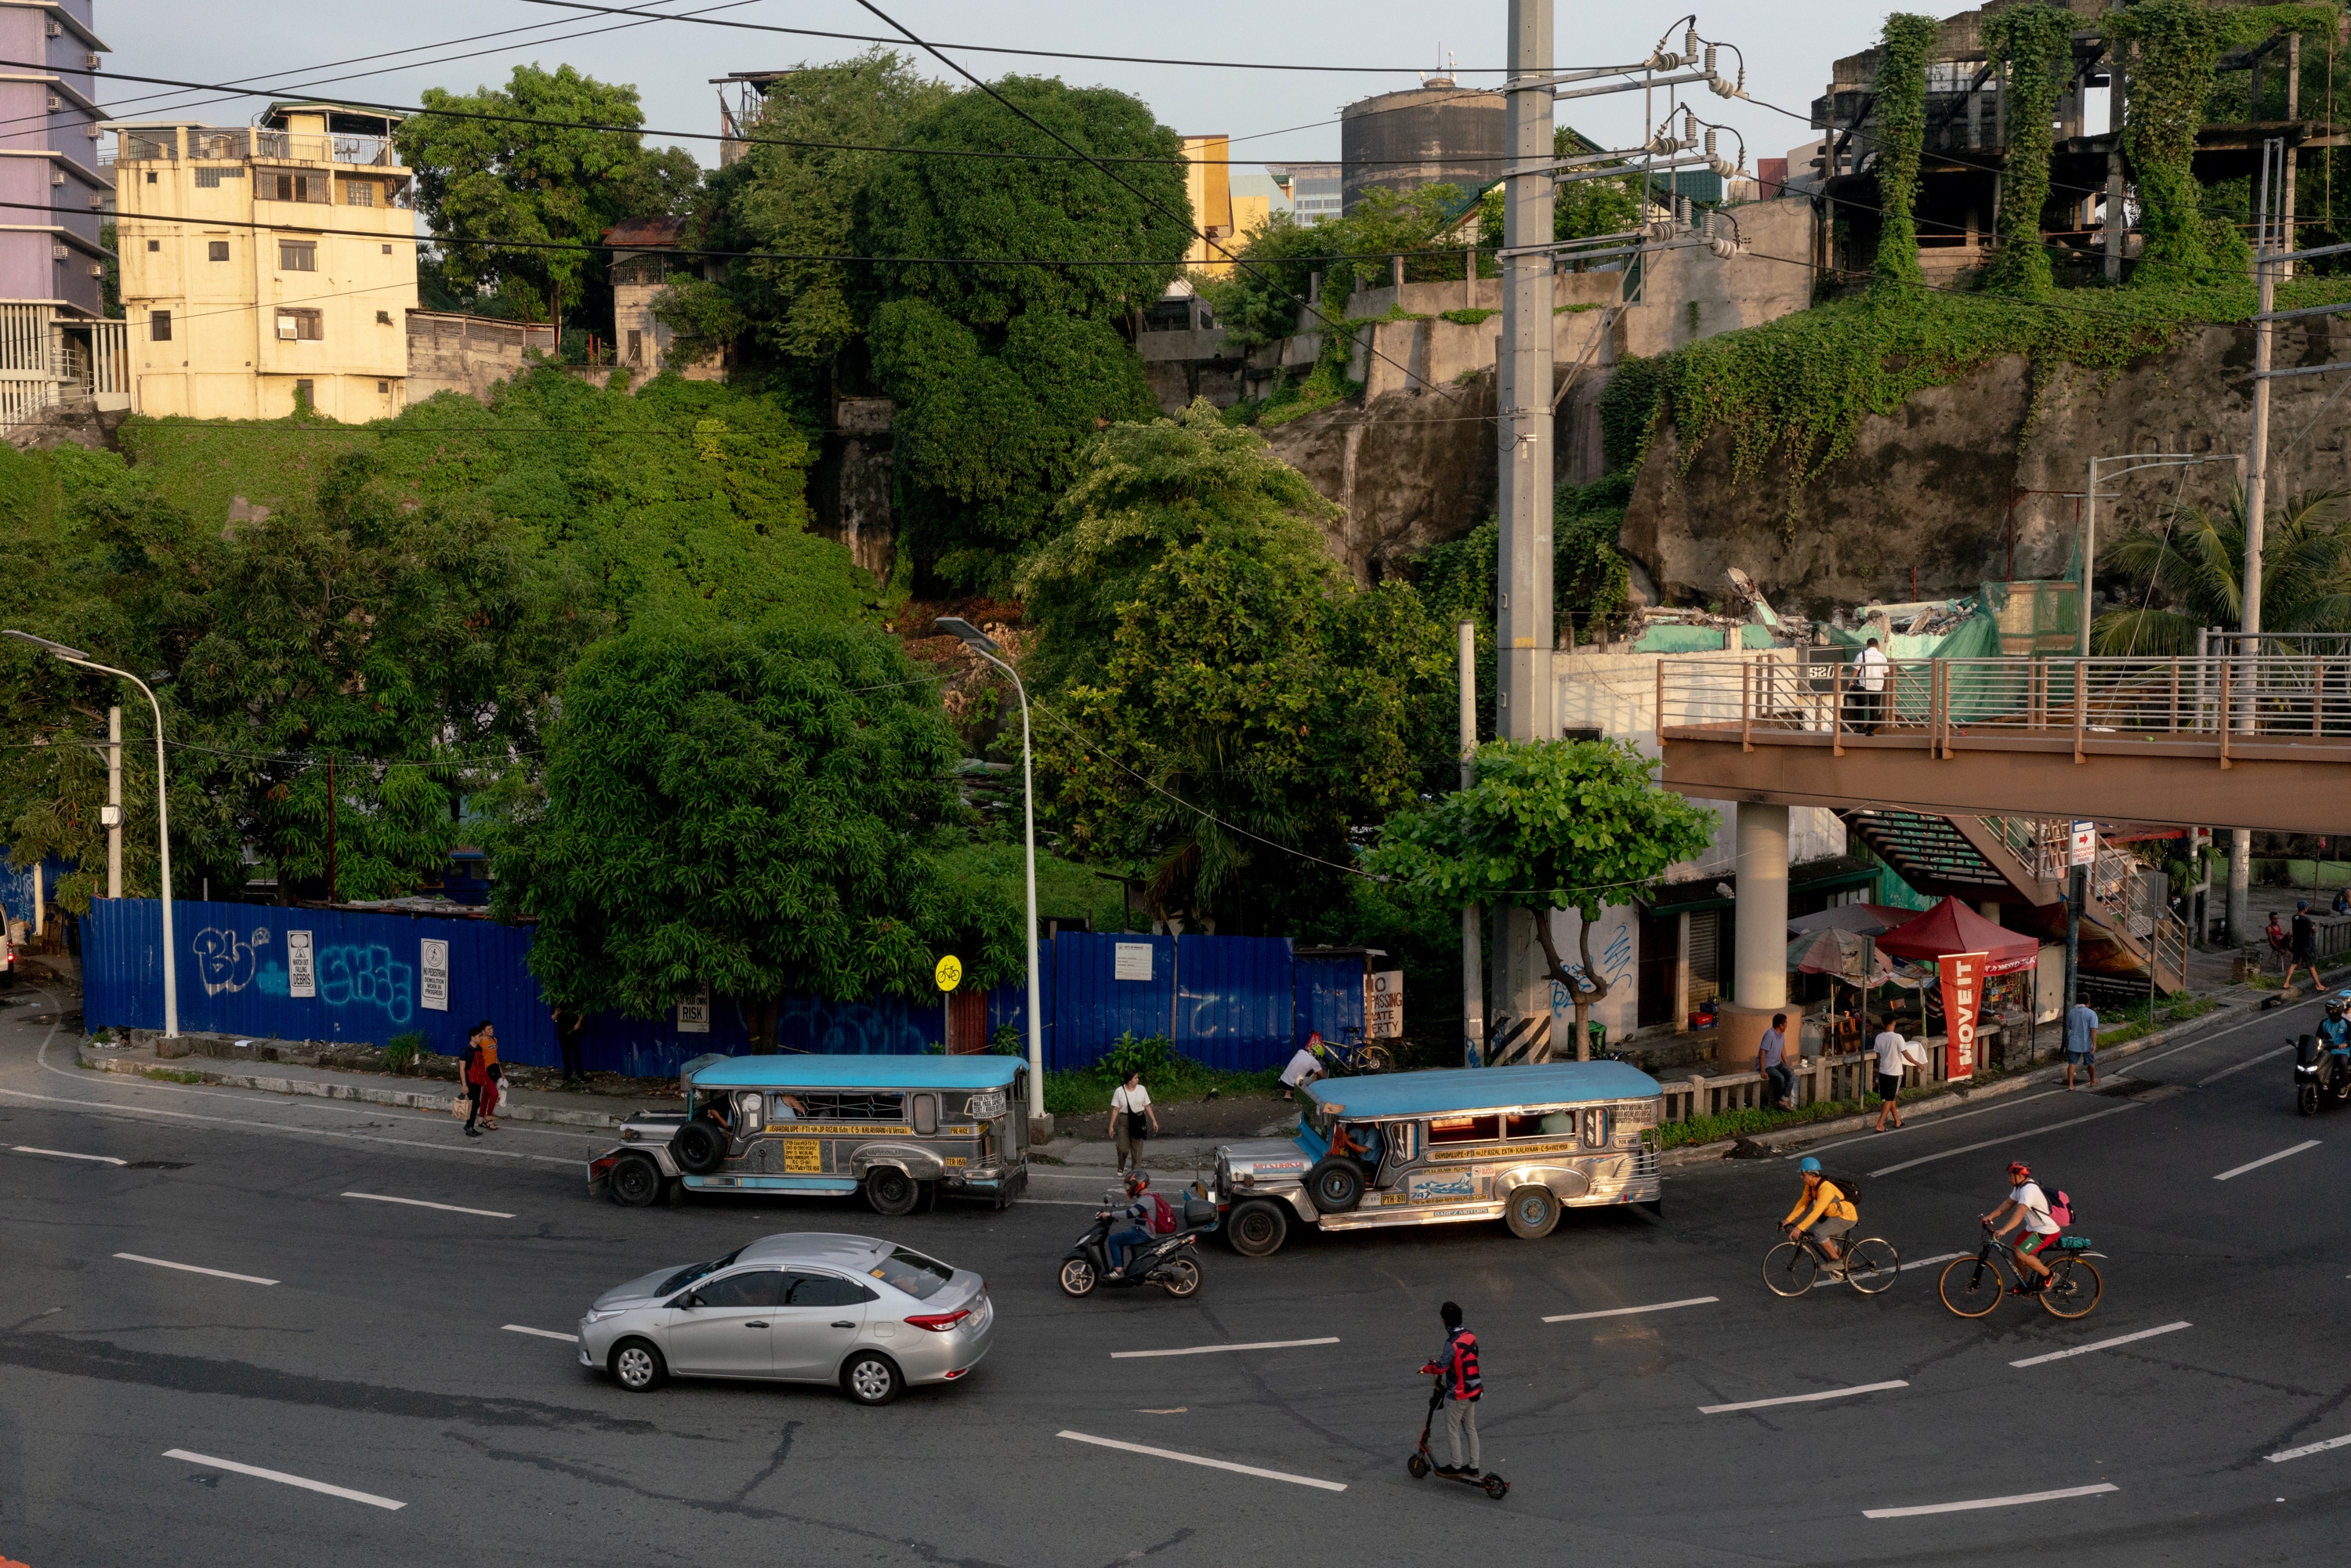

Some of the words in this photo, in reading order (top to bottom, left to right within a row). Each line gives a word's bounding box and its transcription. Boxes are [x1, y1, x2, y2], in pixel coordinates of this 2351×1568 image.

[429, 969, 445, 977] PEDESTRIAN
[293, 974, 310, 985] DEBRIS
[683, 1007, 703, 1020] RISK
[1383, 1194, 1406, 1204] PYH-811
